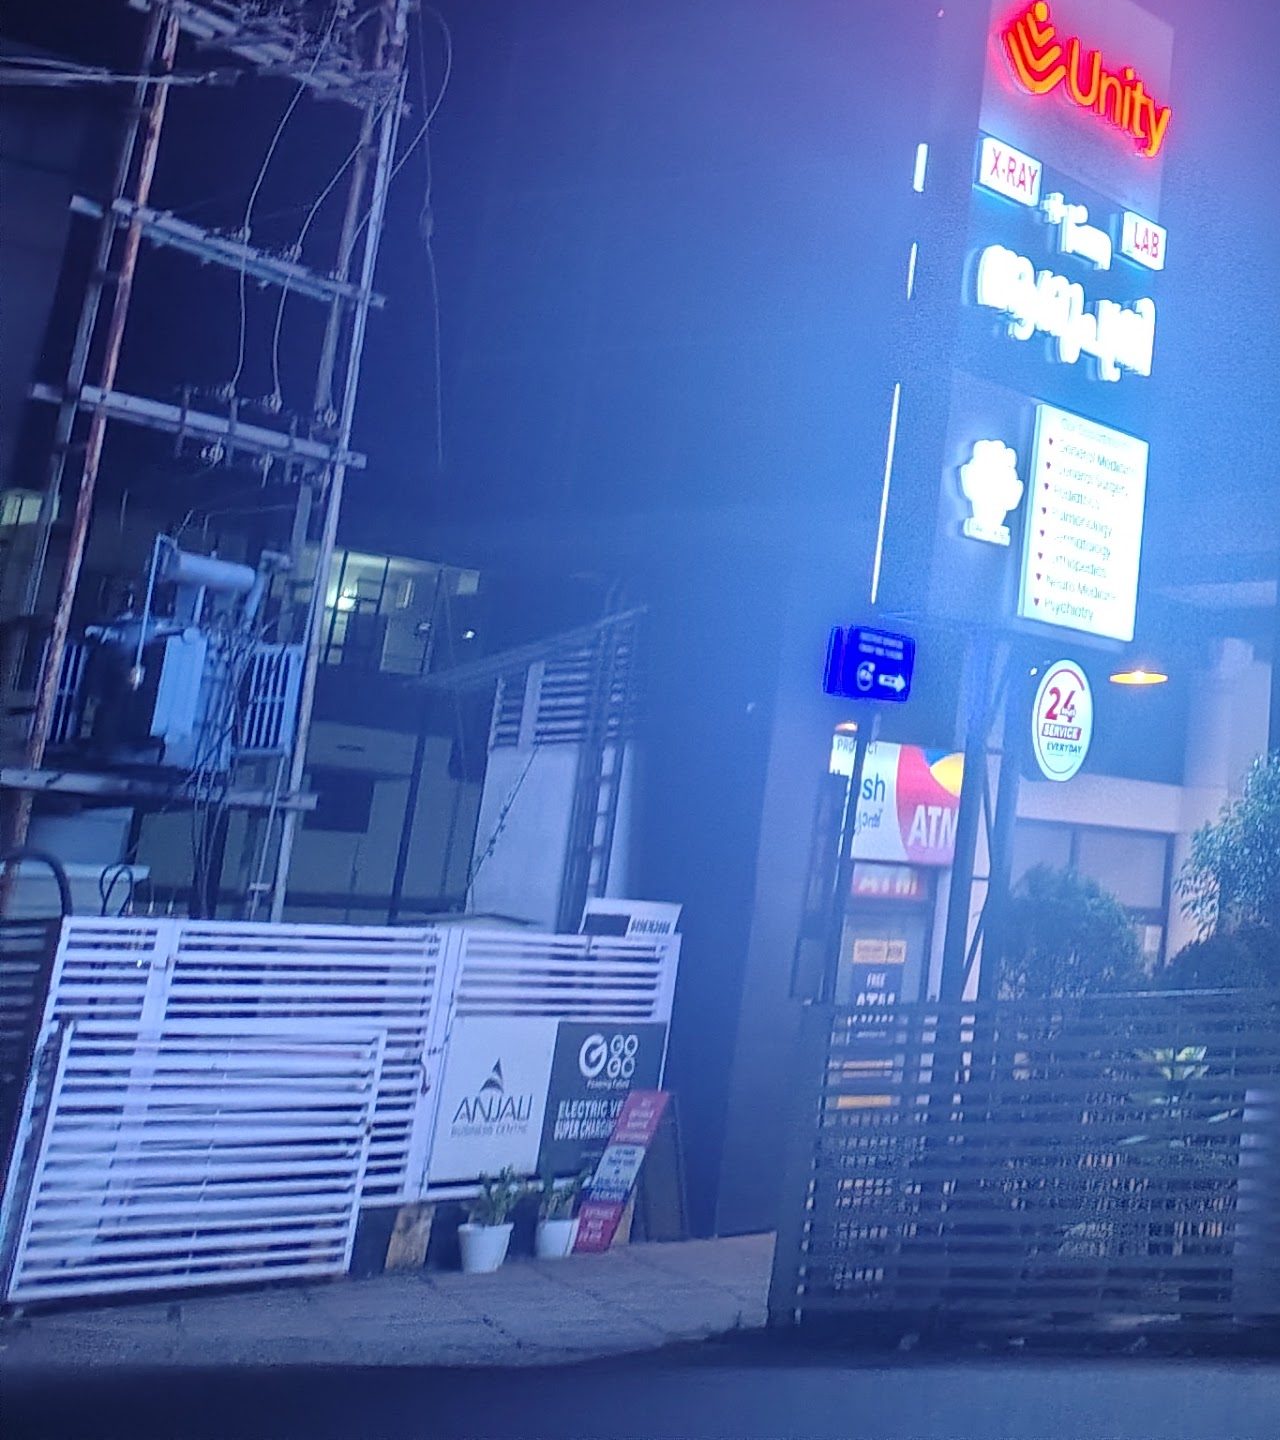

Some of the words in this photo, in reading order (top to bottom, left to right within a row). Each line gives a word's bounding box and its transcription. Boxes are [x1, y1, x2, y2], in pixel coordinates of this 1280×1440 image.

[1066, 39, 1171, 158] Unity
[990, 148, 1038, 195] X-RAY
[1134, 222, 1159, 258] LAB
[1045, 686, 1076, 723] 24
[1043, 723, 1081, 740] SERVICE
[1047, 741, 1083, 755] EVERYDAY
[452, 1093, 533, 1125] ANJALI
[558, 1098, 608, 1119] ELECTRIC
